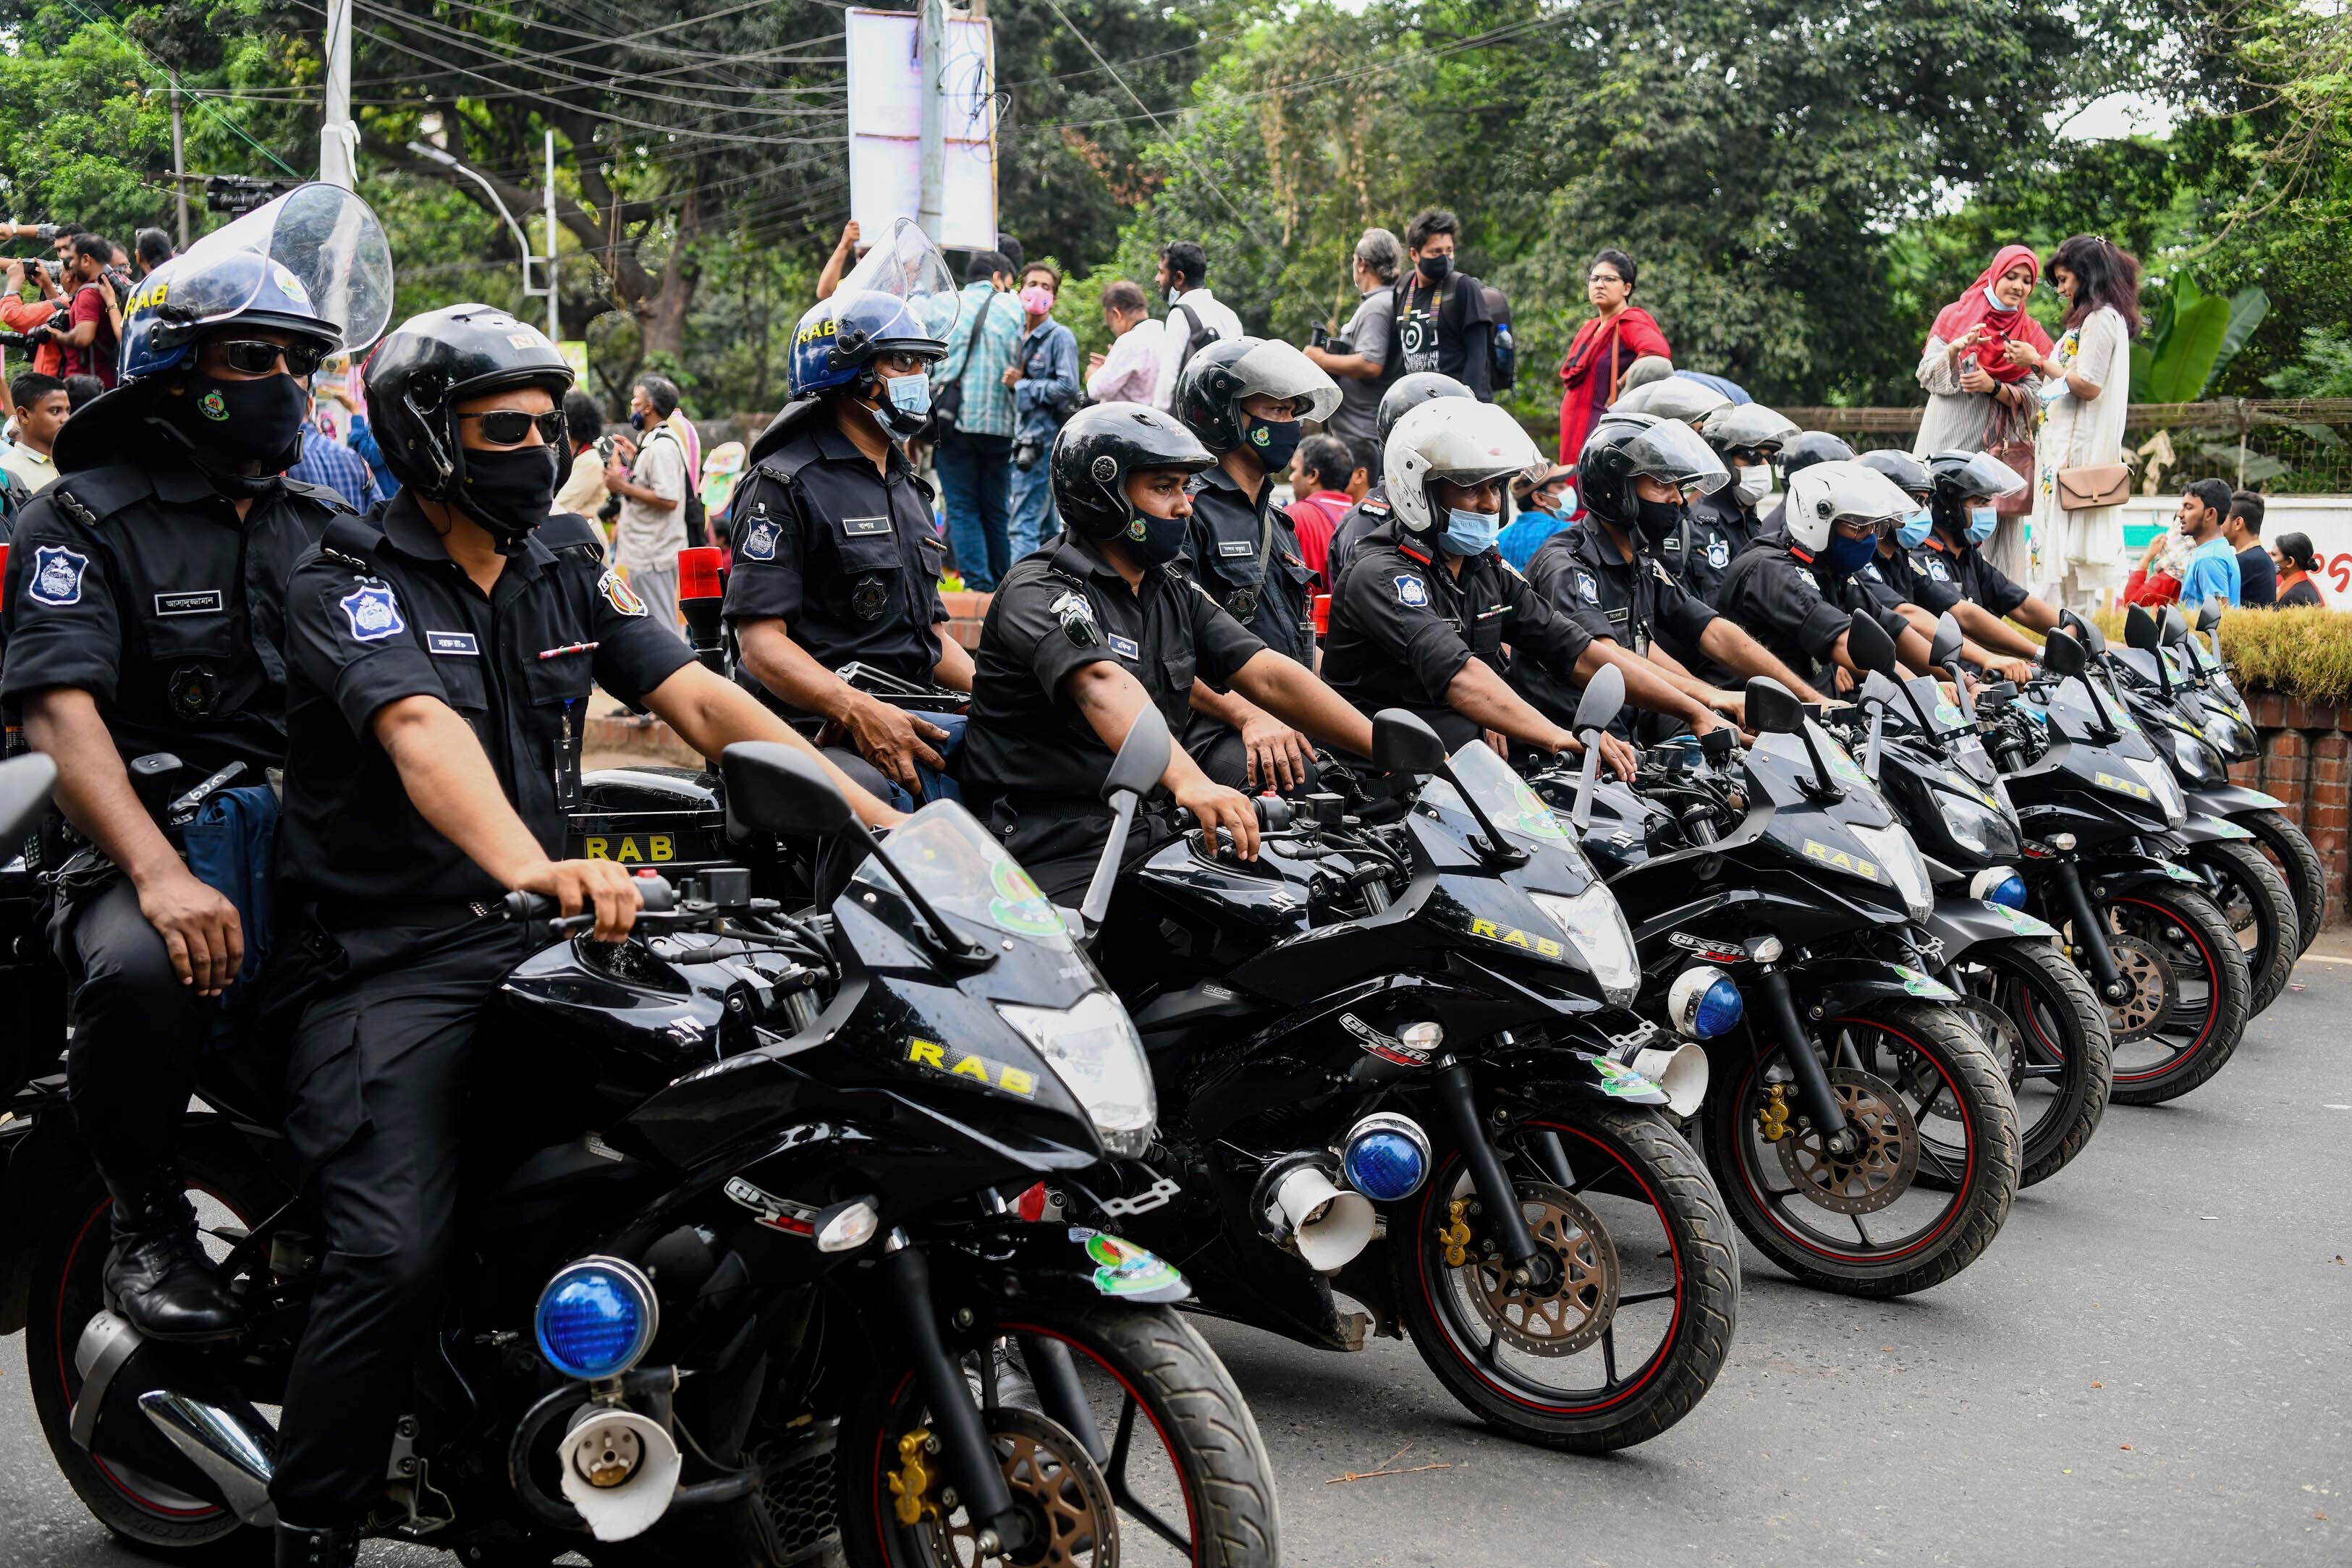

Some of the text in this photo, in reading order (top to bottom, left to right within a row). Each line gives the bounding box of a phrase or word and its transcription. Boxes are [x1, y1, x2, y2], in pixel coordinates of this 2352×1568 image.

[124, 283, 168, 320] RAB
[797, 320, 837, 345] RAB
[2099, 774, 2150, 800] RAB
[586, 835, 673, 863] RAB
[1806, 842, 1875, 877] RAB
[1472, 918, 1560, 957] RAB
[1670, 933, 1746, 956] GIXXER
[1204, 985, 1232, 995] SEP
[1342, 1015, 1428, 1061] GIXXER
[909, 1039, 1033, 1094] RAB
